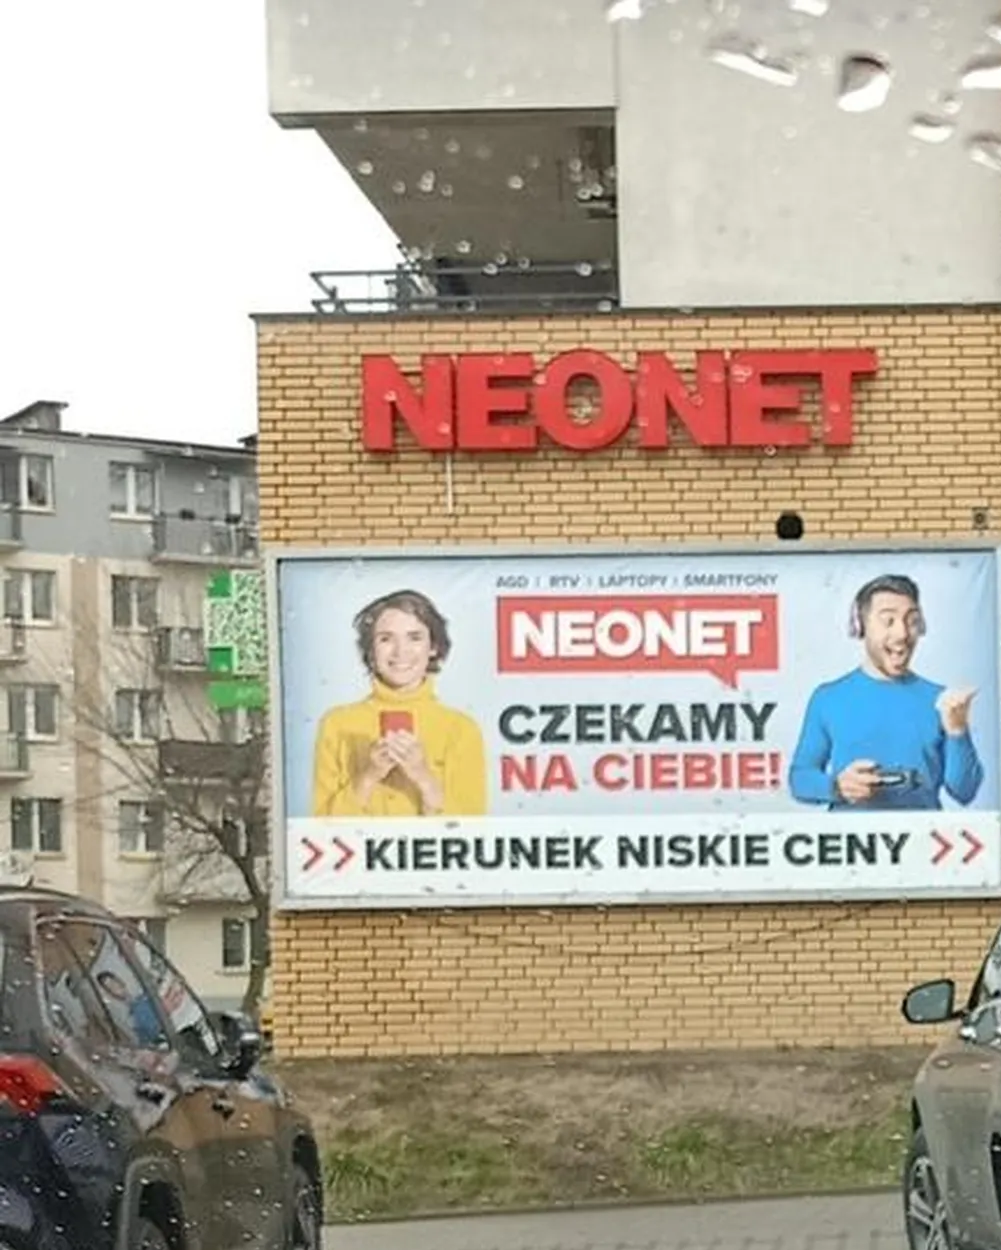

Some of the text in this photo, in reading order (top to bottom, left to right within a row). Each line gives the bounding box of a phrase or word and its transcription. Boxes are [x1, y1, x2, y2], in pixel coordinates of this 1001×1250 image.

[362, 348, 877, 452] NEONET
[496, 573, 779, 588] AGD RTV LAPTOPY SMARTFONY
[510, 608, 763, 659] NEONET
[499, 703, 778, 743] CZEKAMY
[500, 751, 782, 792] NA CIEBIE!
[365, 830, 911, 872] KIERUNEK NISKIE CENY
